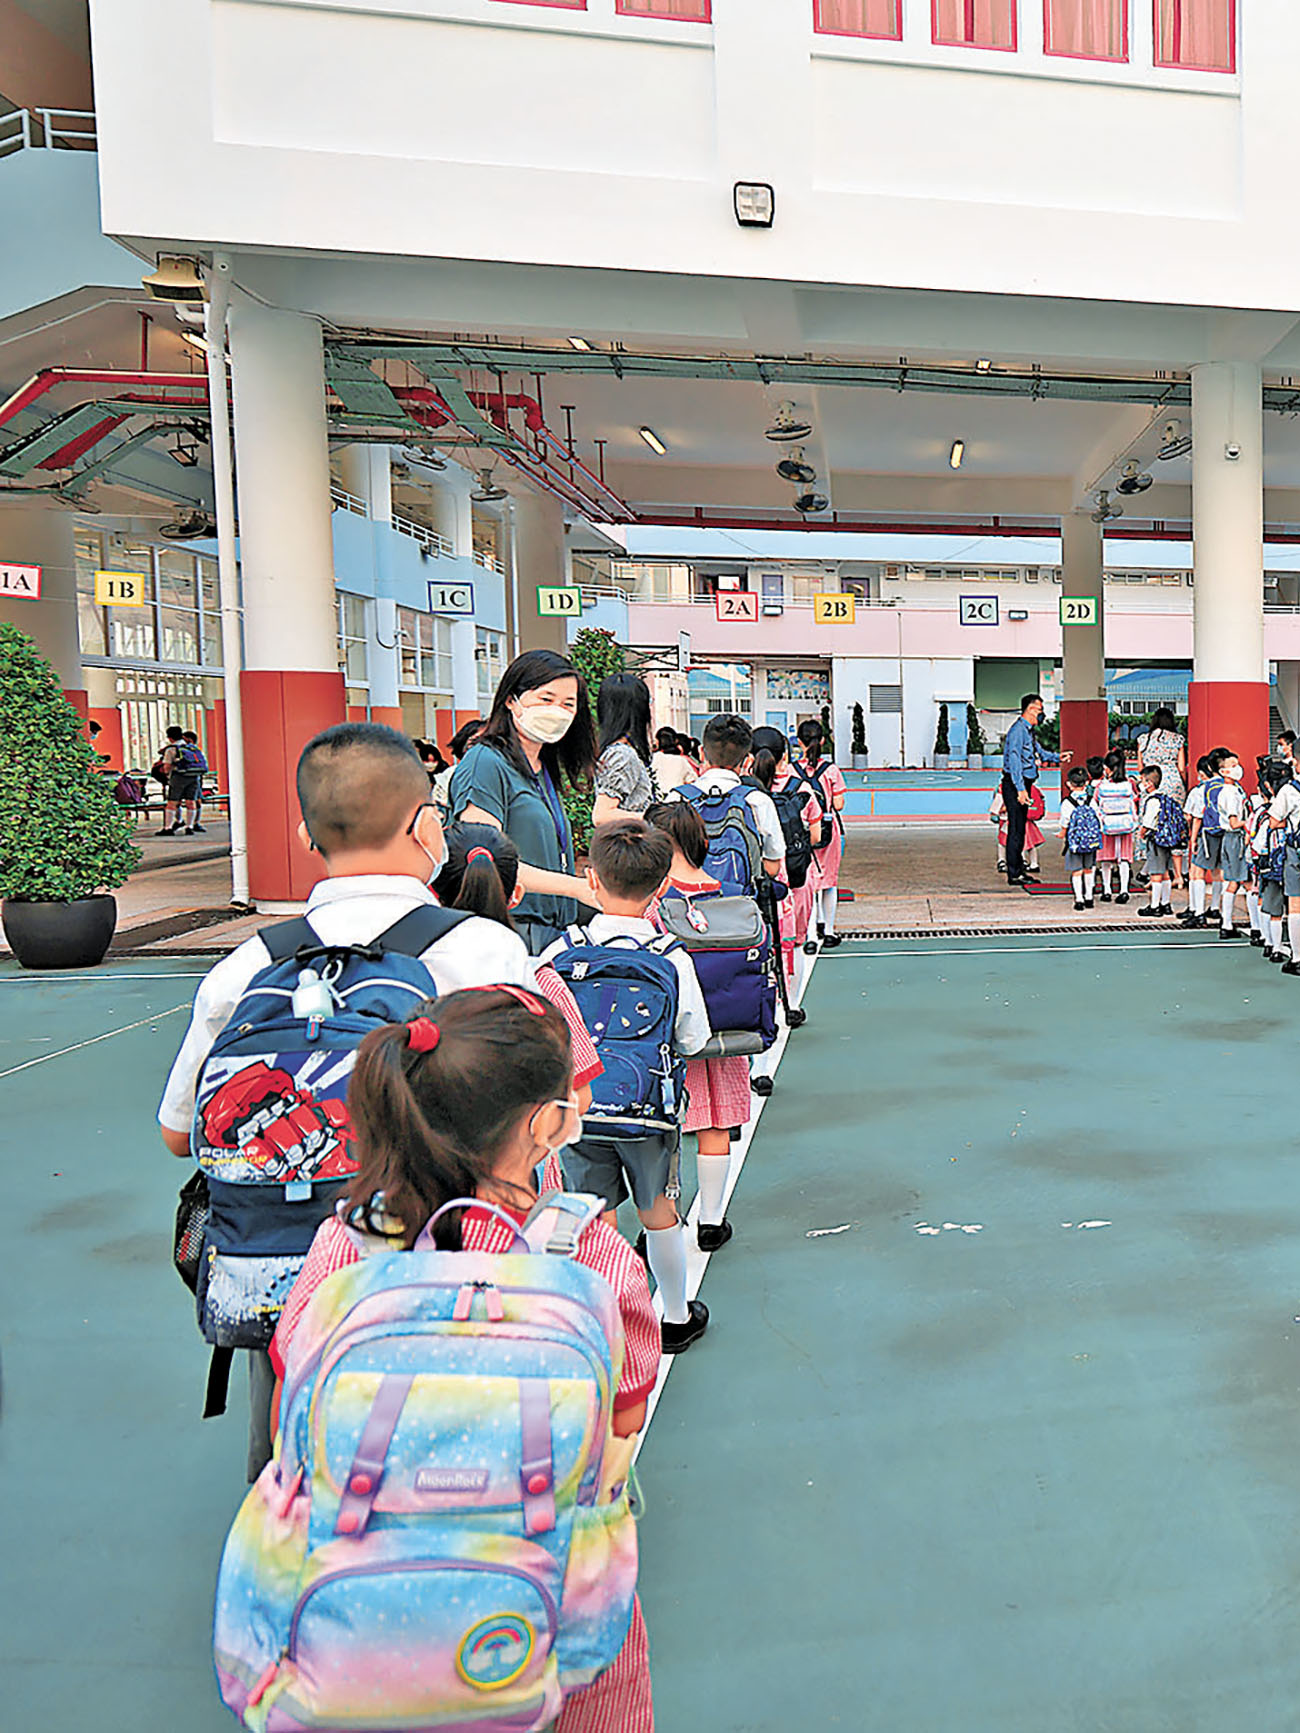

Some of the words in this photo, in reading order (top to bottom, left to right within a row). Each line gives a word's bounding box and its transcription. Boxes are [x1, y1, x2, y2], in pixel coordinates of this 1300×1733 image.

[3, 572, 32, 591] 1A
[107, 581, 136, 599] 1B
[438, 590, 466, 608] 1C
[547, 593, 574, 610] 1D
[724, 599, 751, 616] 2A
[822, 601, 848, 617] 2B
[967, 603, 992, 619] 2C
[1066, 603, 1091, 618] 2D
[199, 1146, 259, 1159] POLAR
